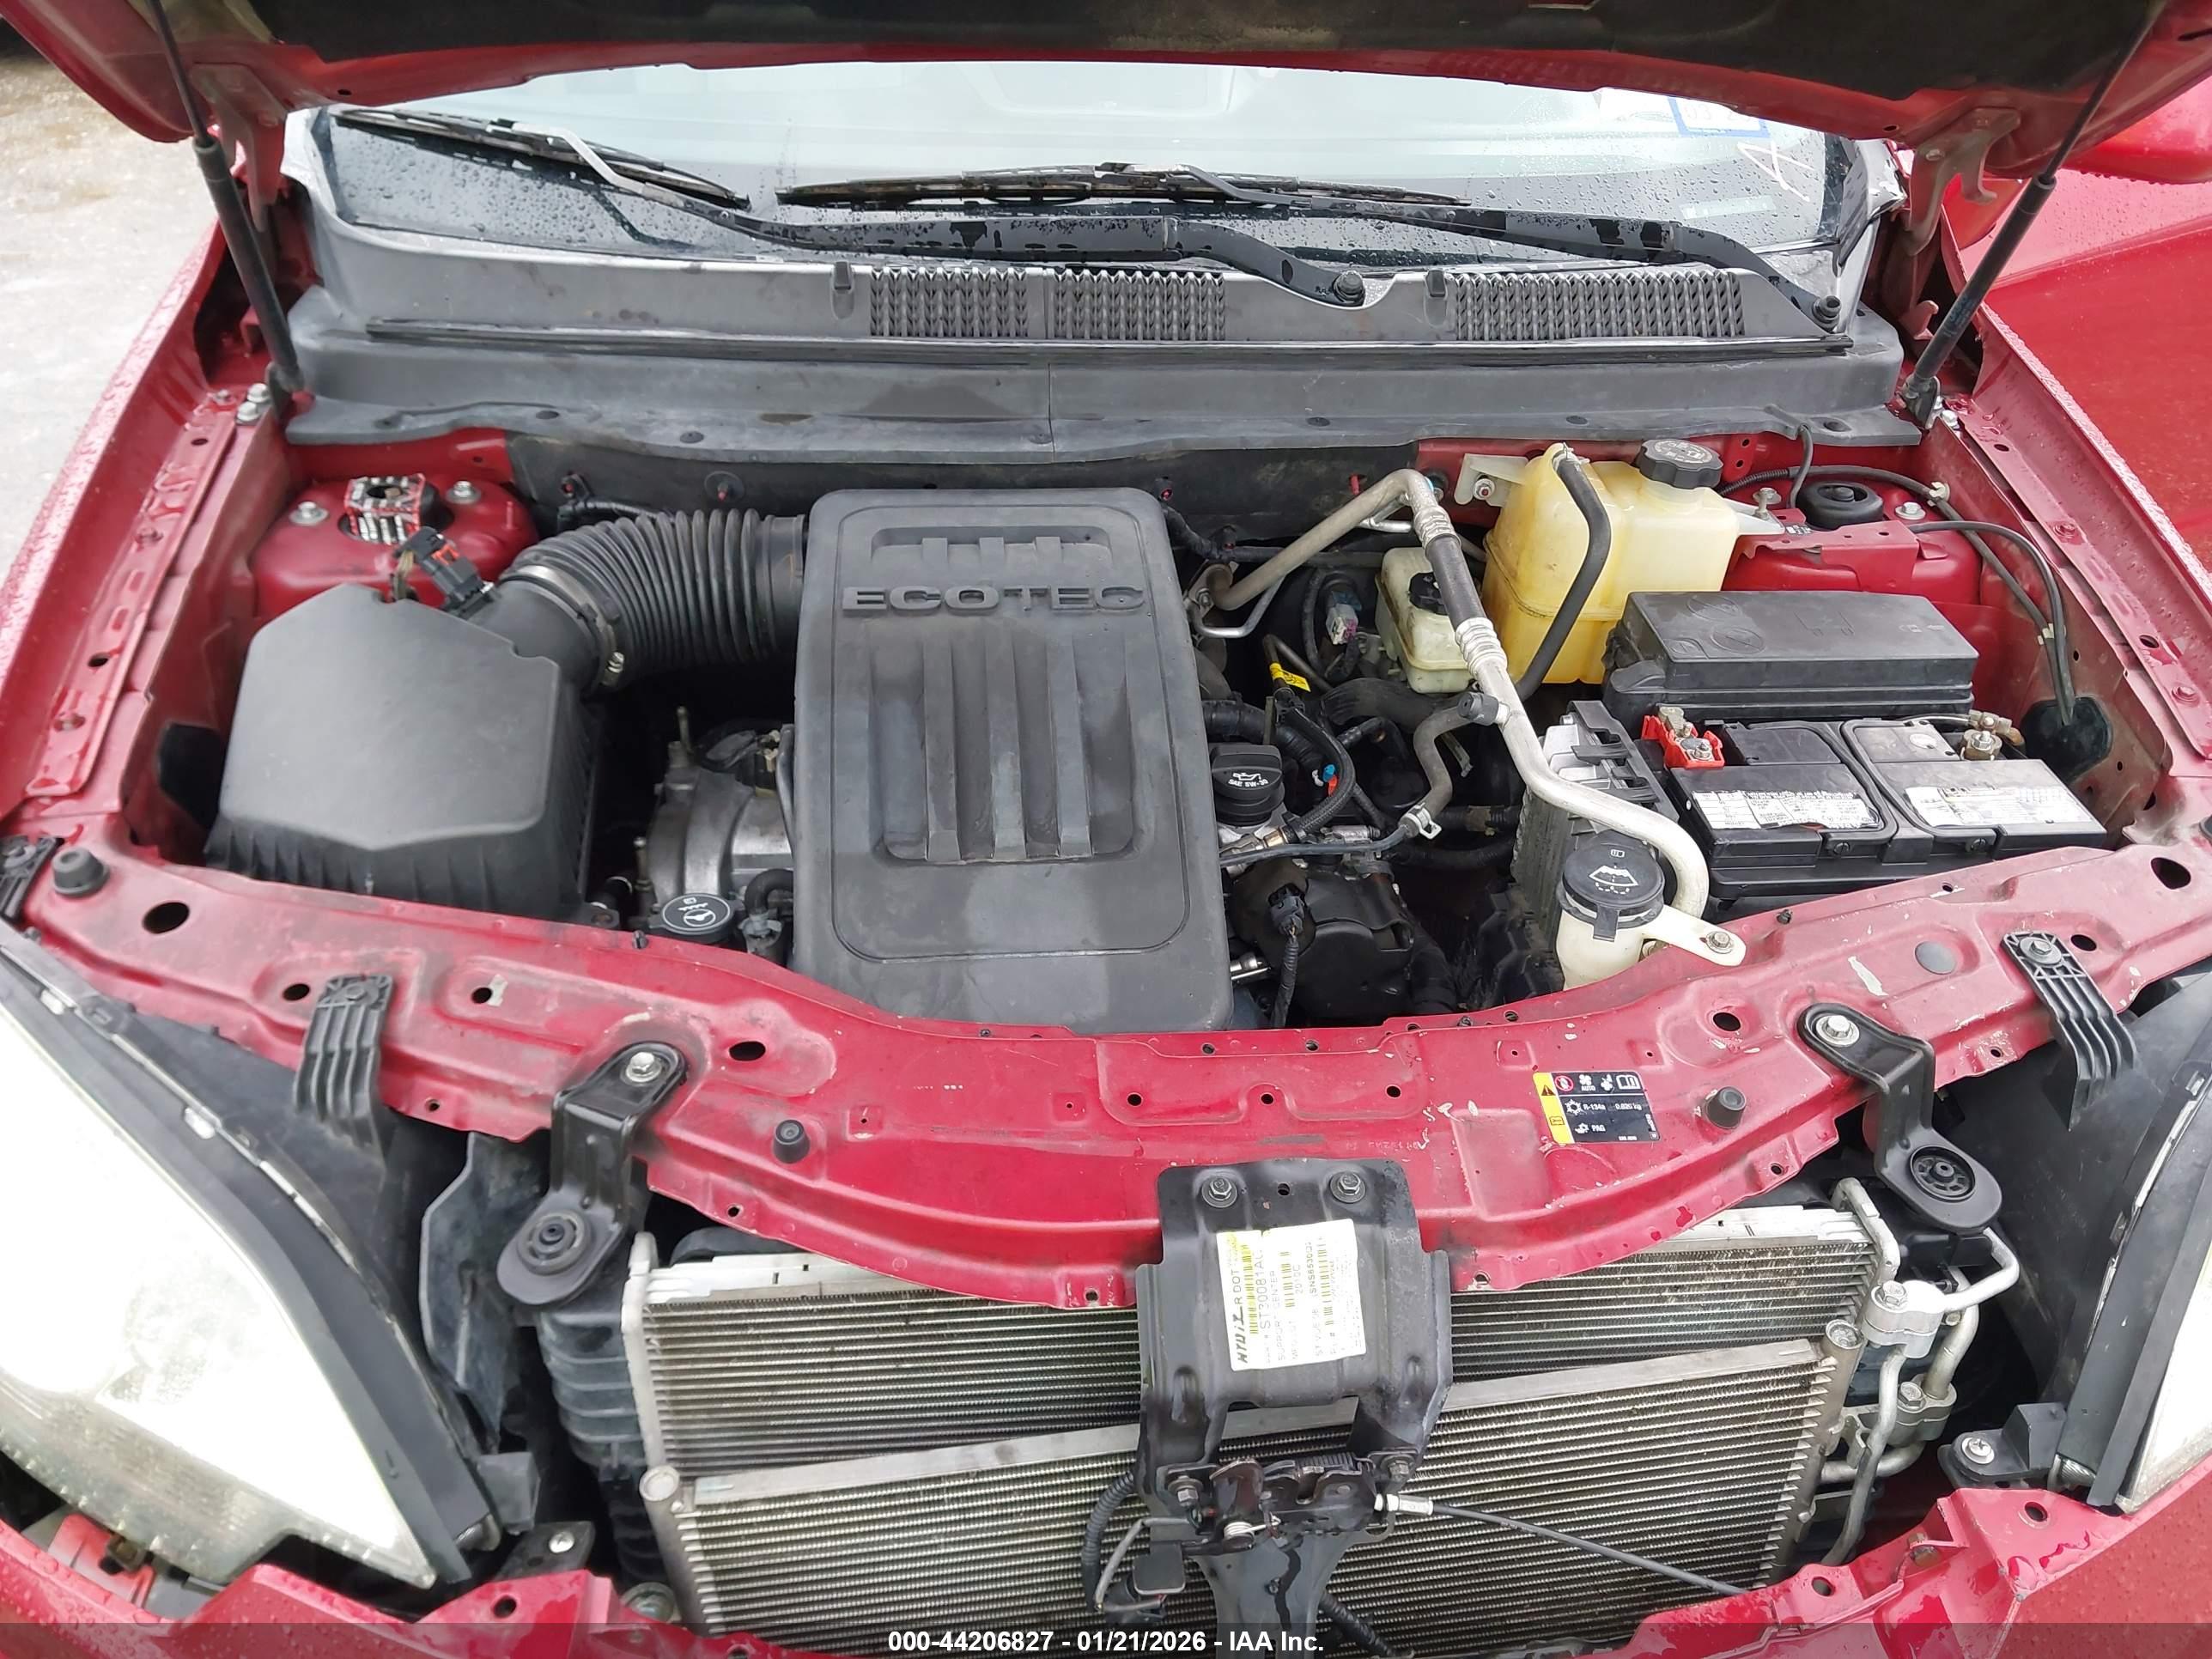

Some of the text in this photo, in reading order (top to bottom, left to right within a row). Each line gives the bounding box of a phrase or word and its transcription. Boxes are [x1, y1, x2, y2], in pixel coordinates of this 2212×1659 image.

[842, 586, 1146, 614] ECOTEC
[1228, 778, 1269, 787] SAE 5W-30
